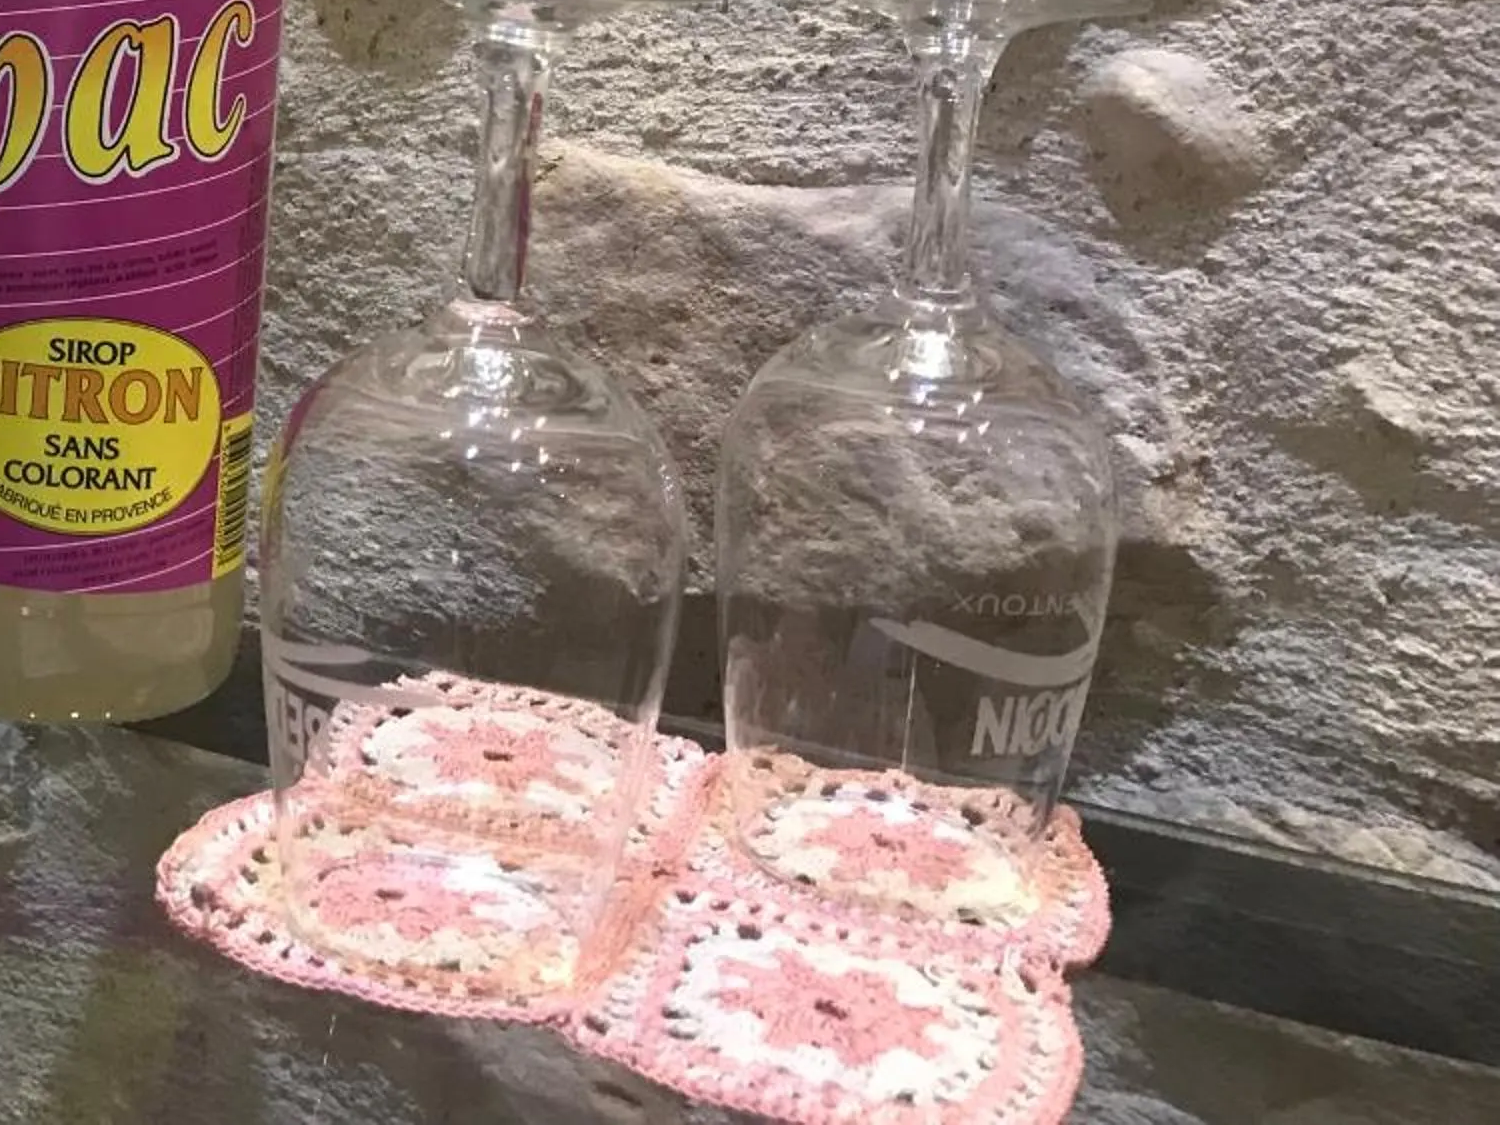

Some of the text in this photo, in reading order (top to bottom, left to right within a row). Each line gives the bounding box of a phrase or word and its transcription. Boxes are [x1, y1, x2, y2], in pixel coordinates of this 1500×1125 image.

[48, 337, 137, 366] SIROP
[43, 434, 121, 460] SANS
[2, 460, 158, 492] COLORANT
[64, 504, 87, 524] EN
[91, 486, 173, 524] PROVENCE
[950, 590, 1083, 618] ENTOUX
